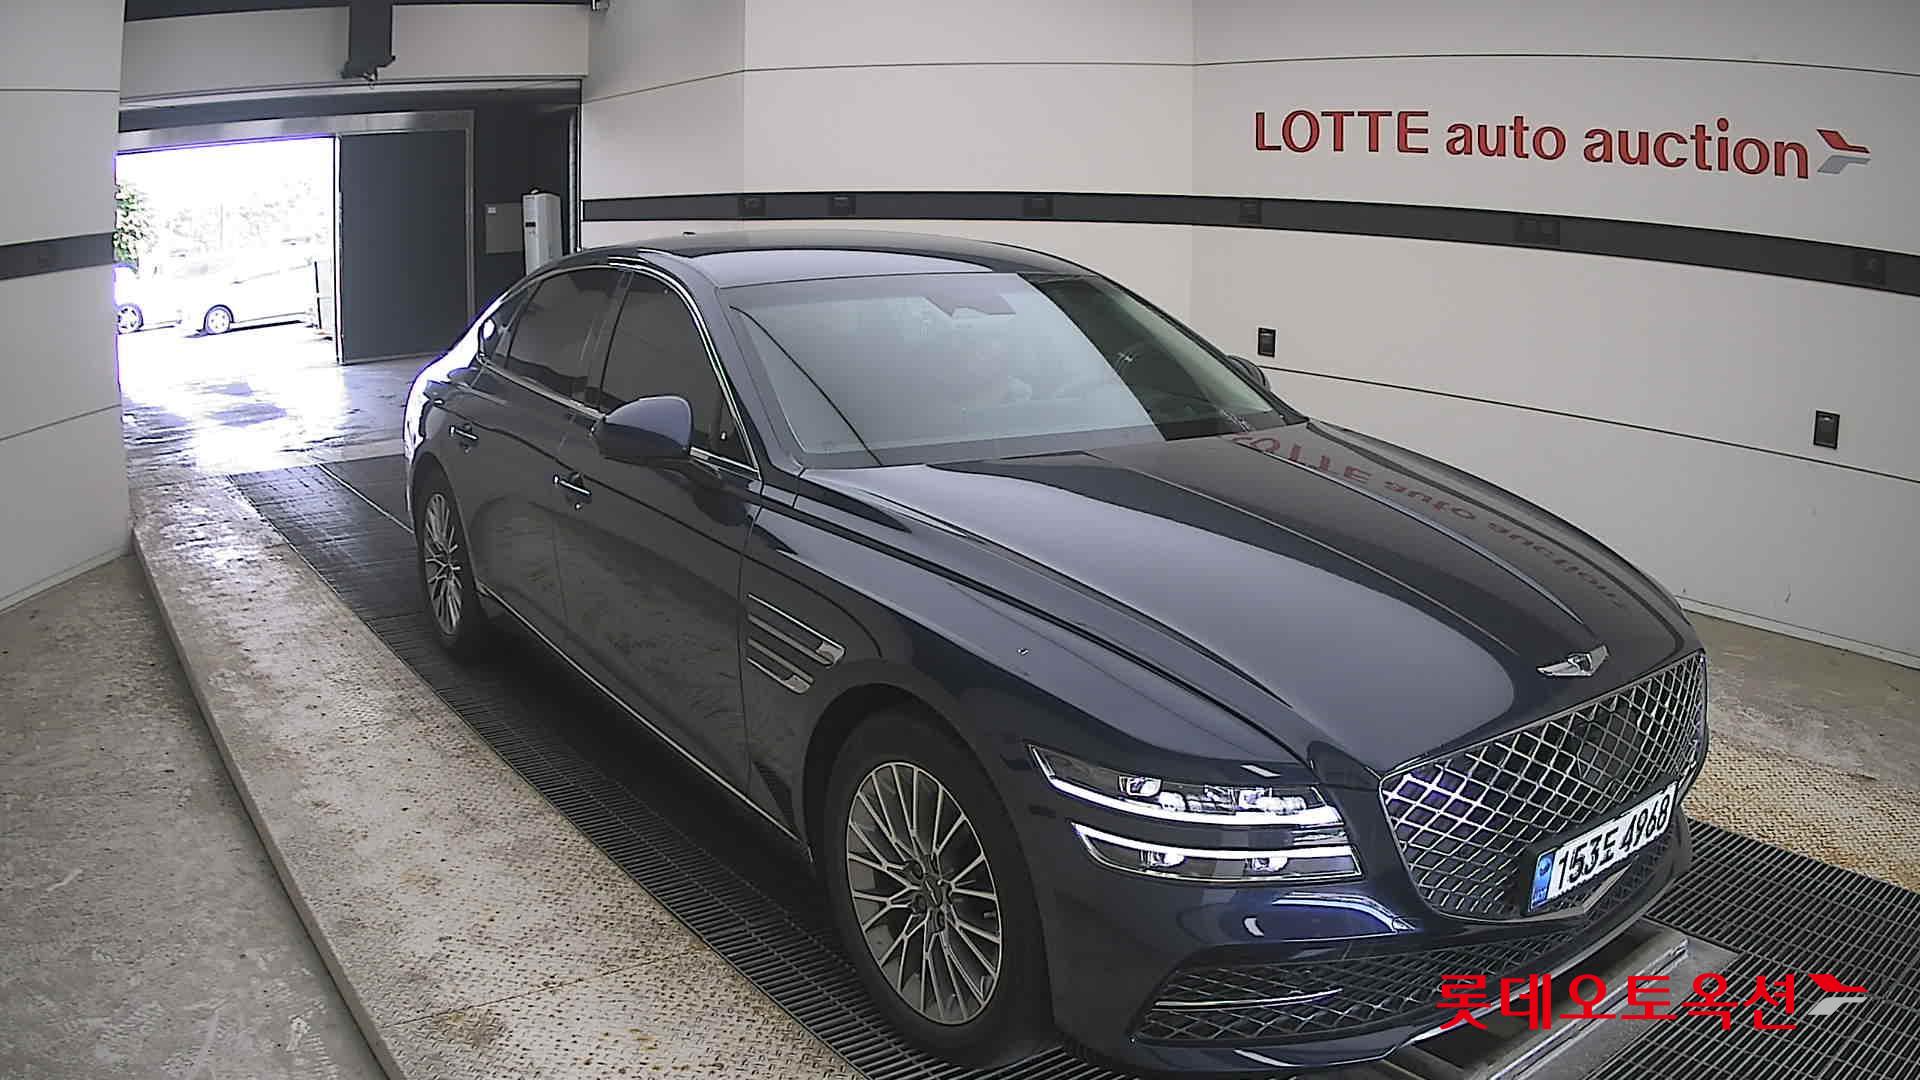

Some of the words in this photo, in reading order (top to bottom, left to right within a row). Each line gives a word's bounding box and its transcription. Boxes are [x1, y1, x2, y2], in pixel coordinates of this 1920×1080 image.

[1254, 110, 1429, 154] LOTTE
[1445, 115, 1567, 160] auto
[1583, 118, 1809, 179] auction
[1619, 794, 1671, 851] 4968
